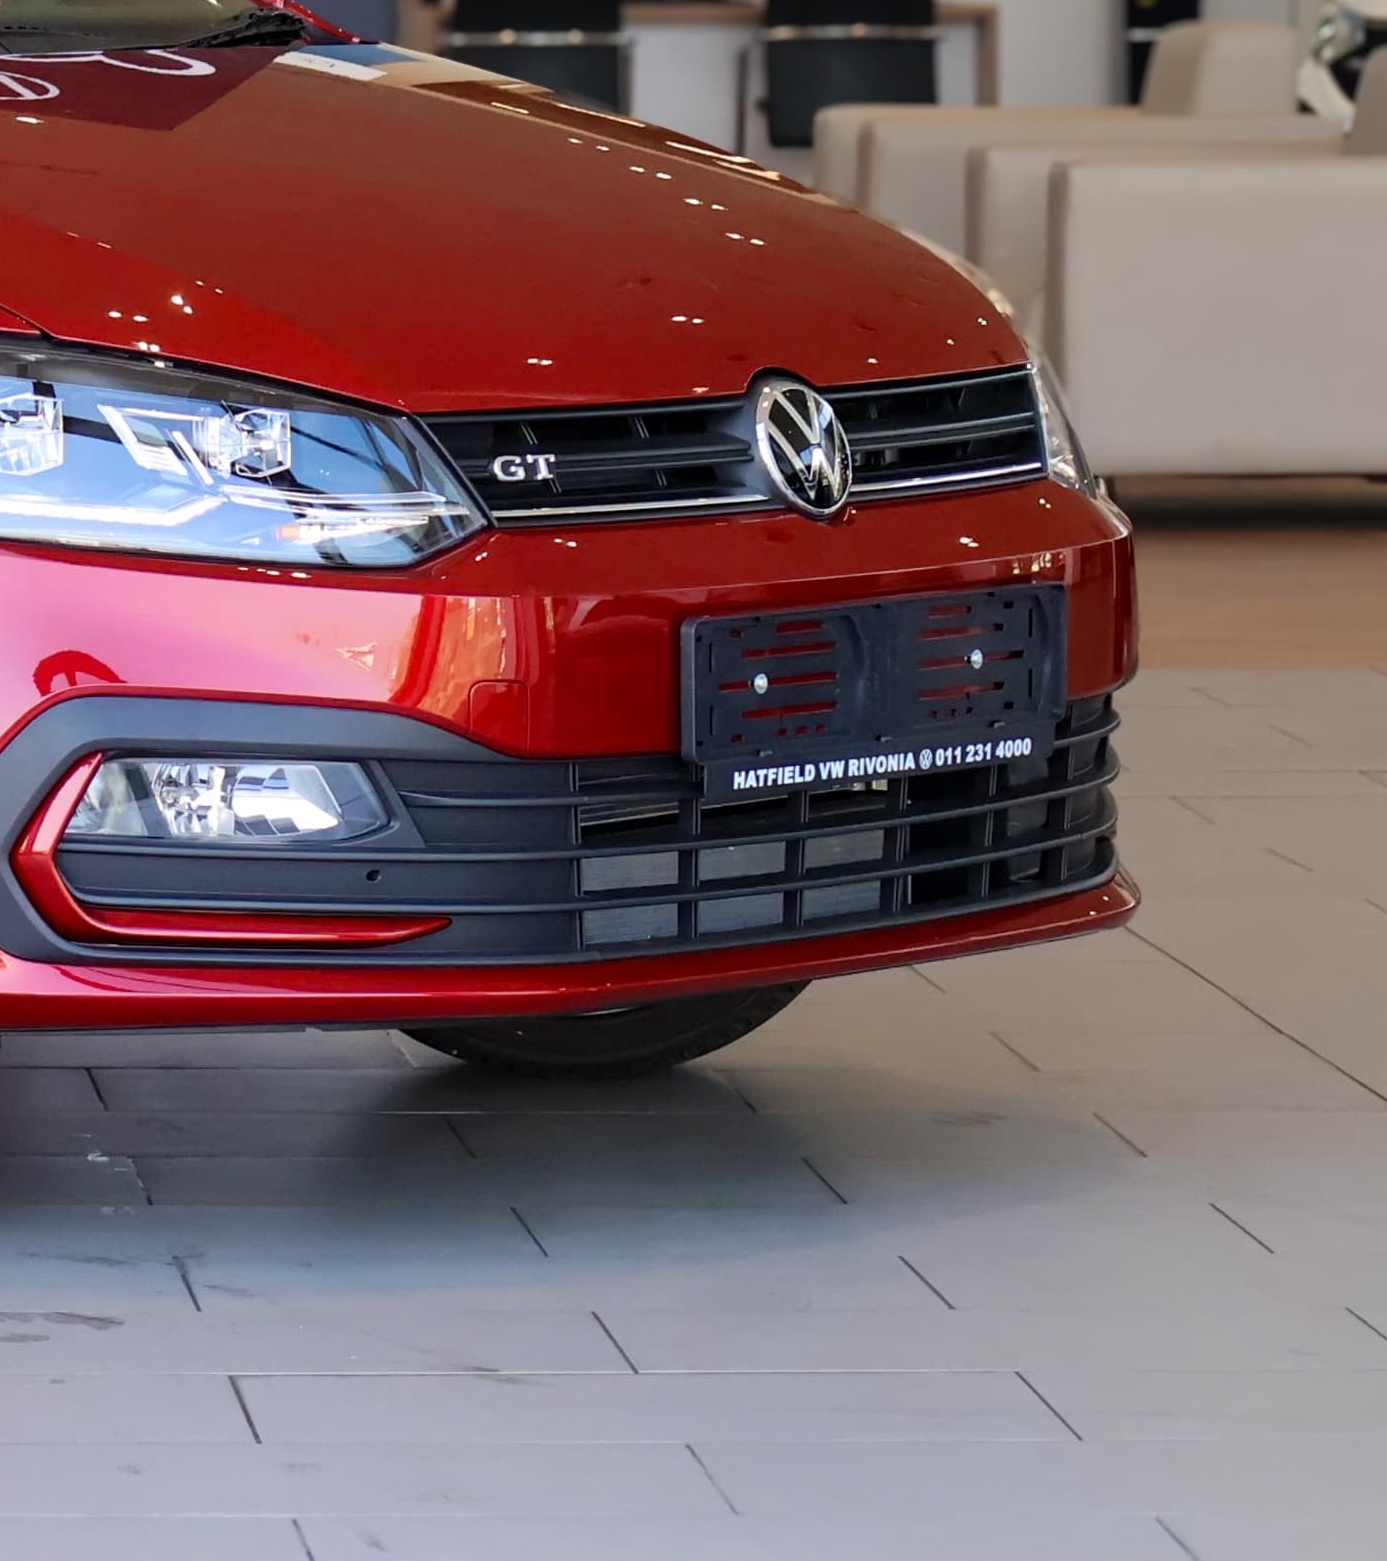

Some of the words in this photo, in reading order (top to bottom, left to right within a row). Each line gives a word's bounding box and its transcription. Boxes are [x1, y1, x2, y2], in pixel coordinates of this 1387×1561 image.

[492, 453, 556, 483] GT
[733, 763, 816, 790] HATFIELD
[819, 760, 845, 781] VW
[848, 752, 916, 777] RIVONIA
[935, 746, 962, 767] 011
[965, 741, 992, 763] 231
[995, 737, 1032, 759] 4000
